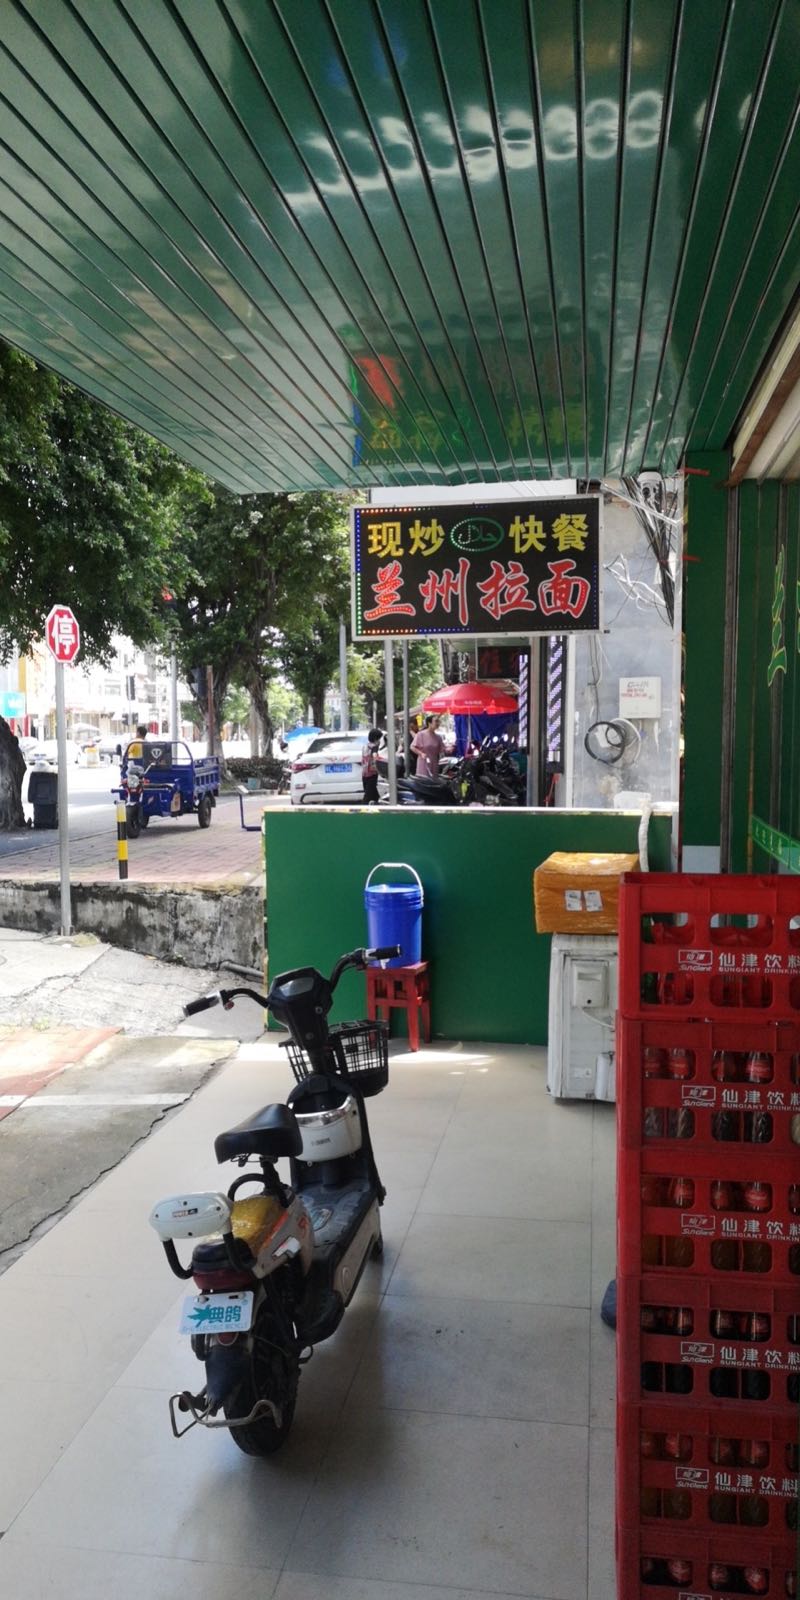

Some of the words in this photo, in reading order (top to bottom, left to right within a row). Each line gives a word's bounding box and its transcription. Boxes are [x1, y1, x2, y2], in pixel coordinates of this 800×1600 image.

[368, 519, 446, 557] 现炒
[508, 513, 589, 554] 快餐
[364, 558, 591, 626] 兰州拉面
[51, 613, 76, 655] 停
[715, 1471, 798, 1492] 仙津饮料
